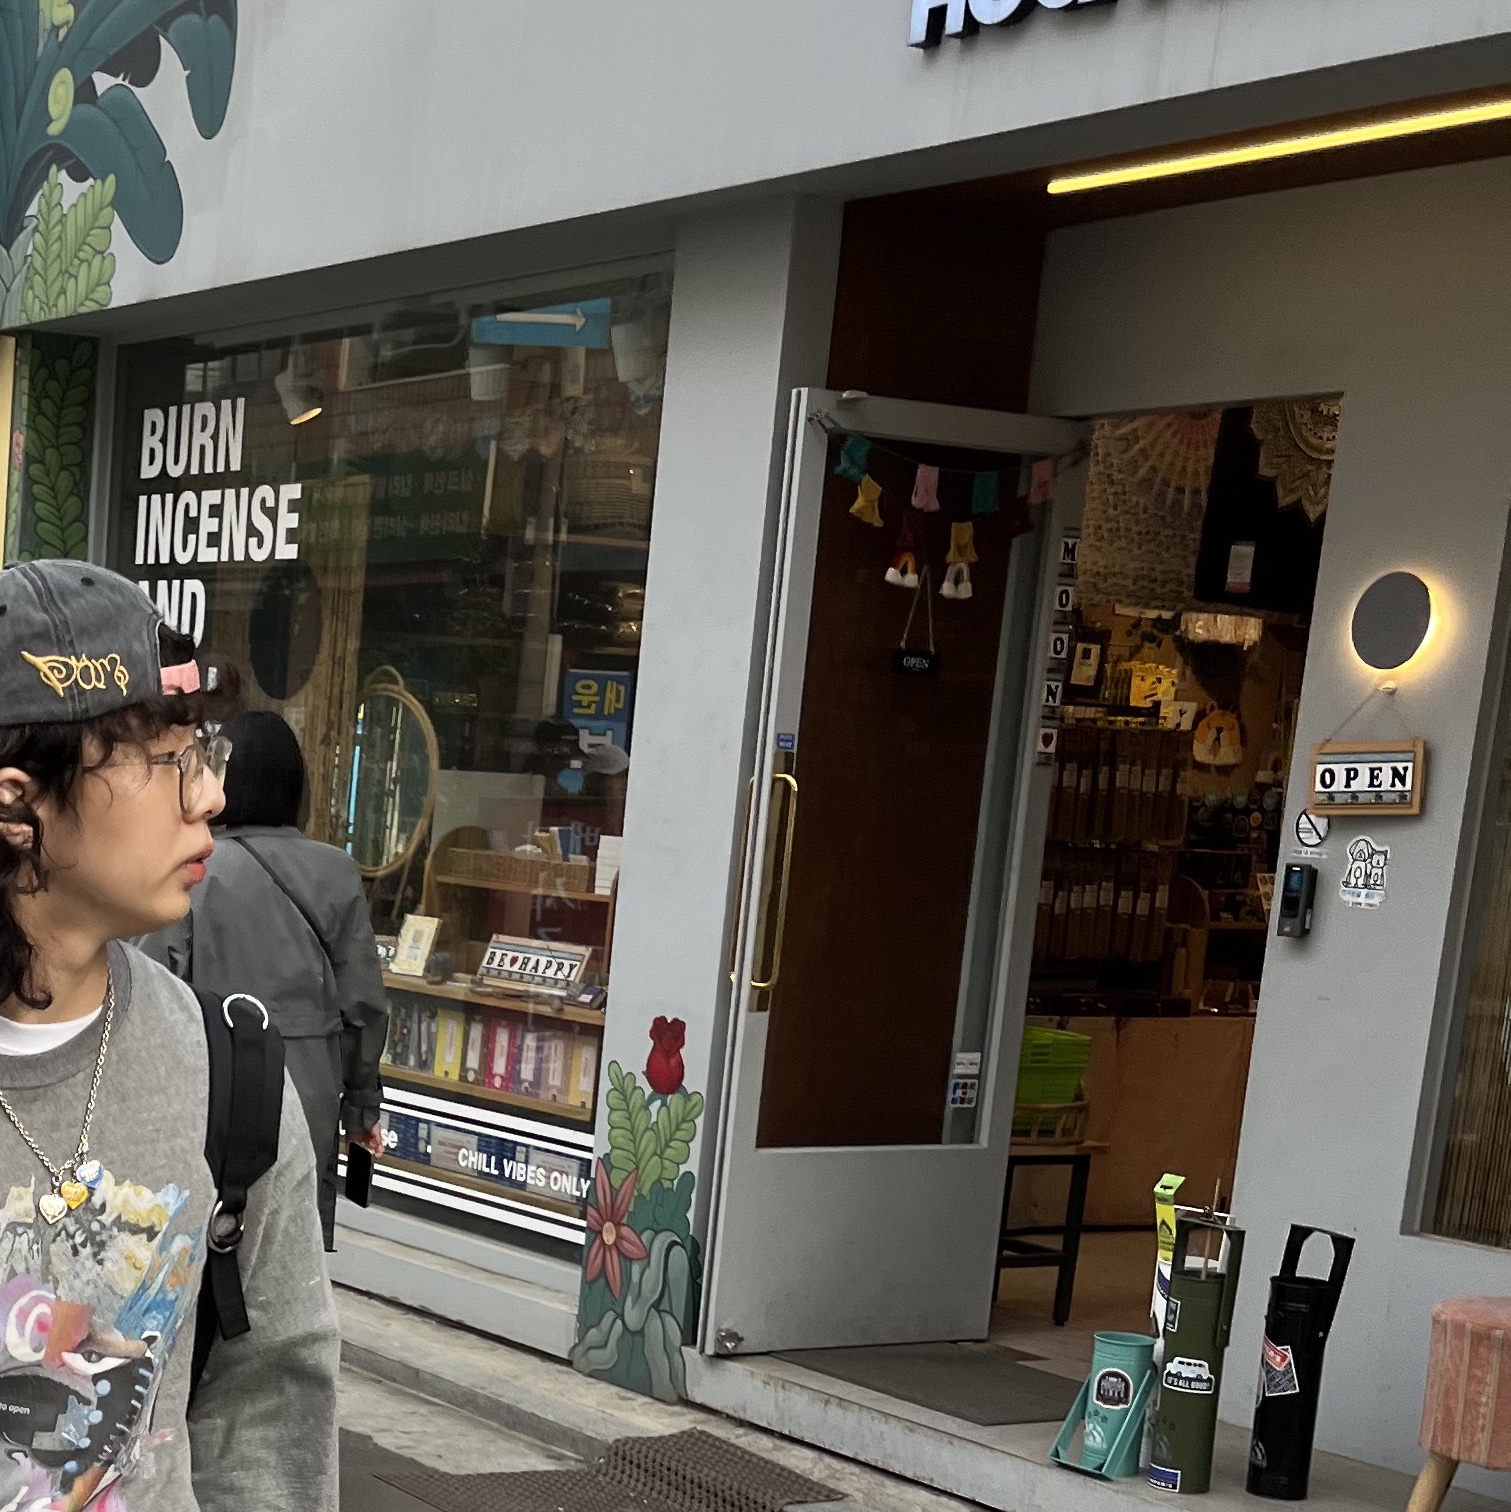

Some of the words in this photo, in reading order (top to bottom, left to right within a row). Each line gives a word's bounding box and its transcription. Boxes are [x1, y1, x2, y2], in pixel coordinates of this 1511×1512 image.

[139, 397, 247, 480] BURN
[134, 483, 303, 565] INCENSE
[138, 579, 206, 649] ND
[902, 656, 930, 669] OPEN
[1319, 765, 1410, 791] OPEN
[486, 951, 509, 967] BE
[519, 956, 578, 979] HAPPY
[458, 1147, 500, 1176] CHILL
[503, 1158, 548, 1187] VIBES
[550, 1170, 592, 1199] ONLY
[8, 1405, 31, 1415] open
